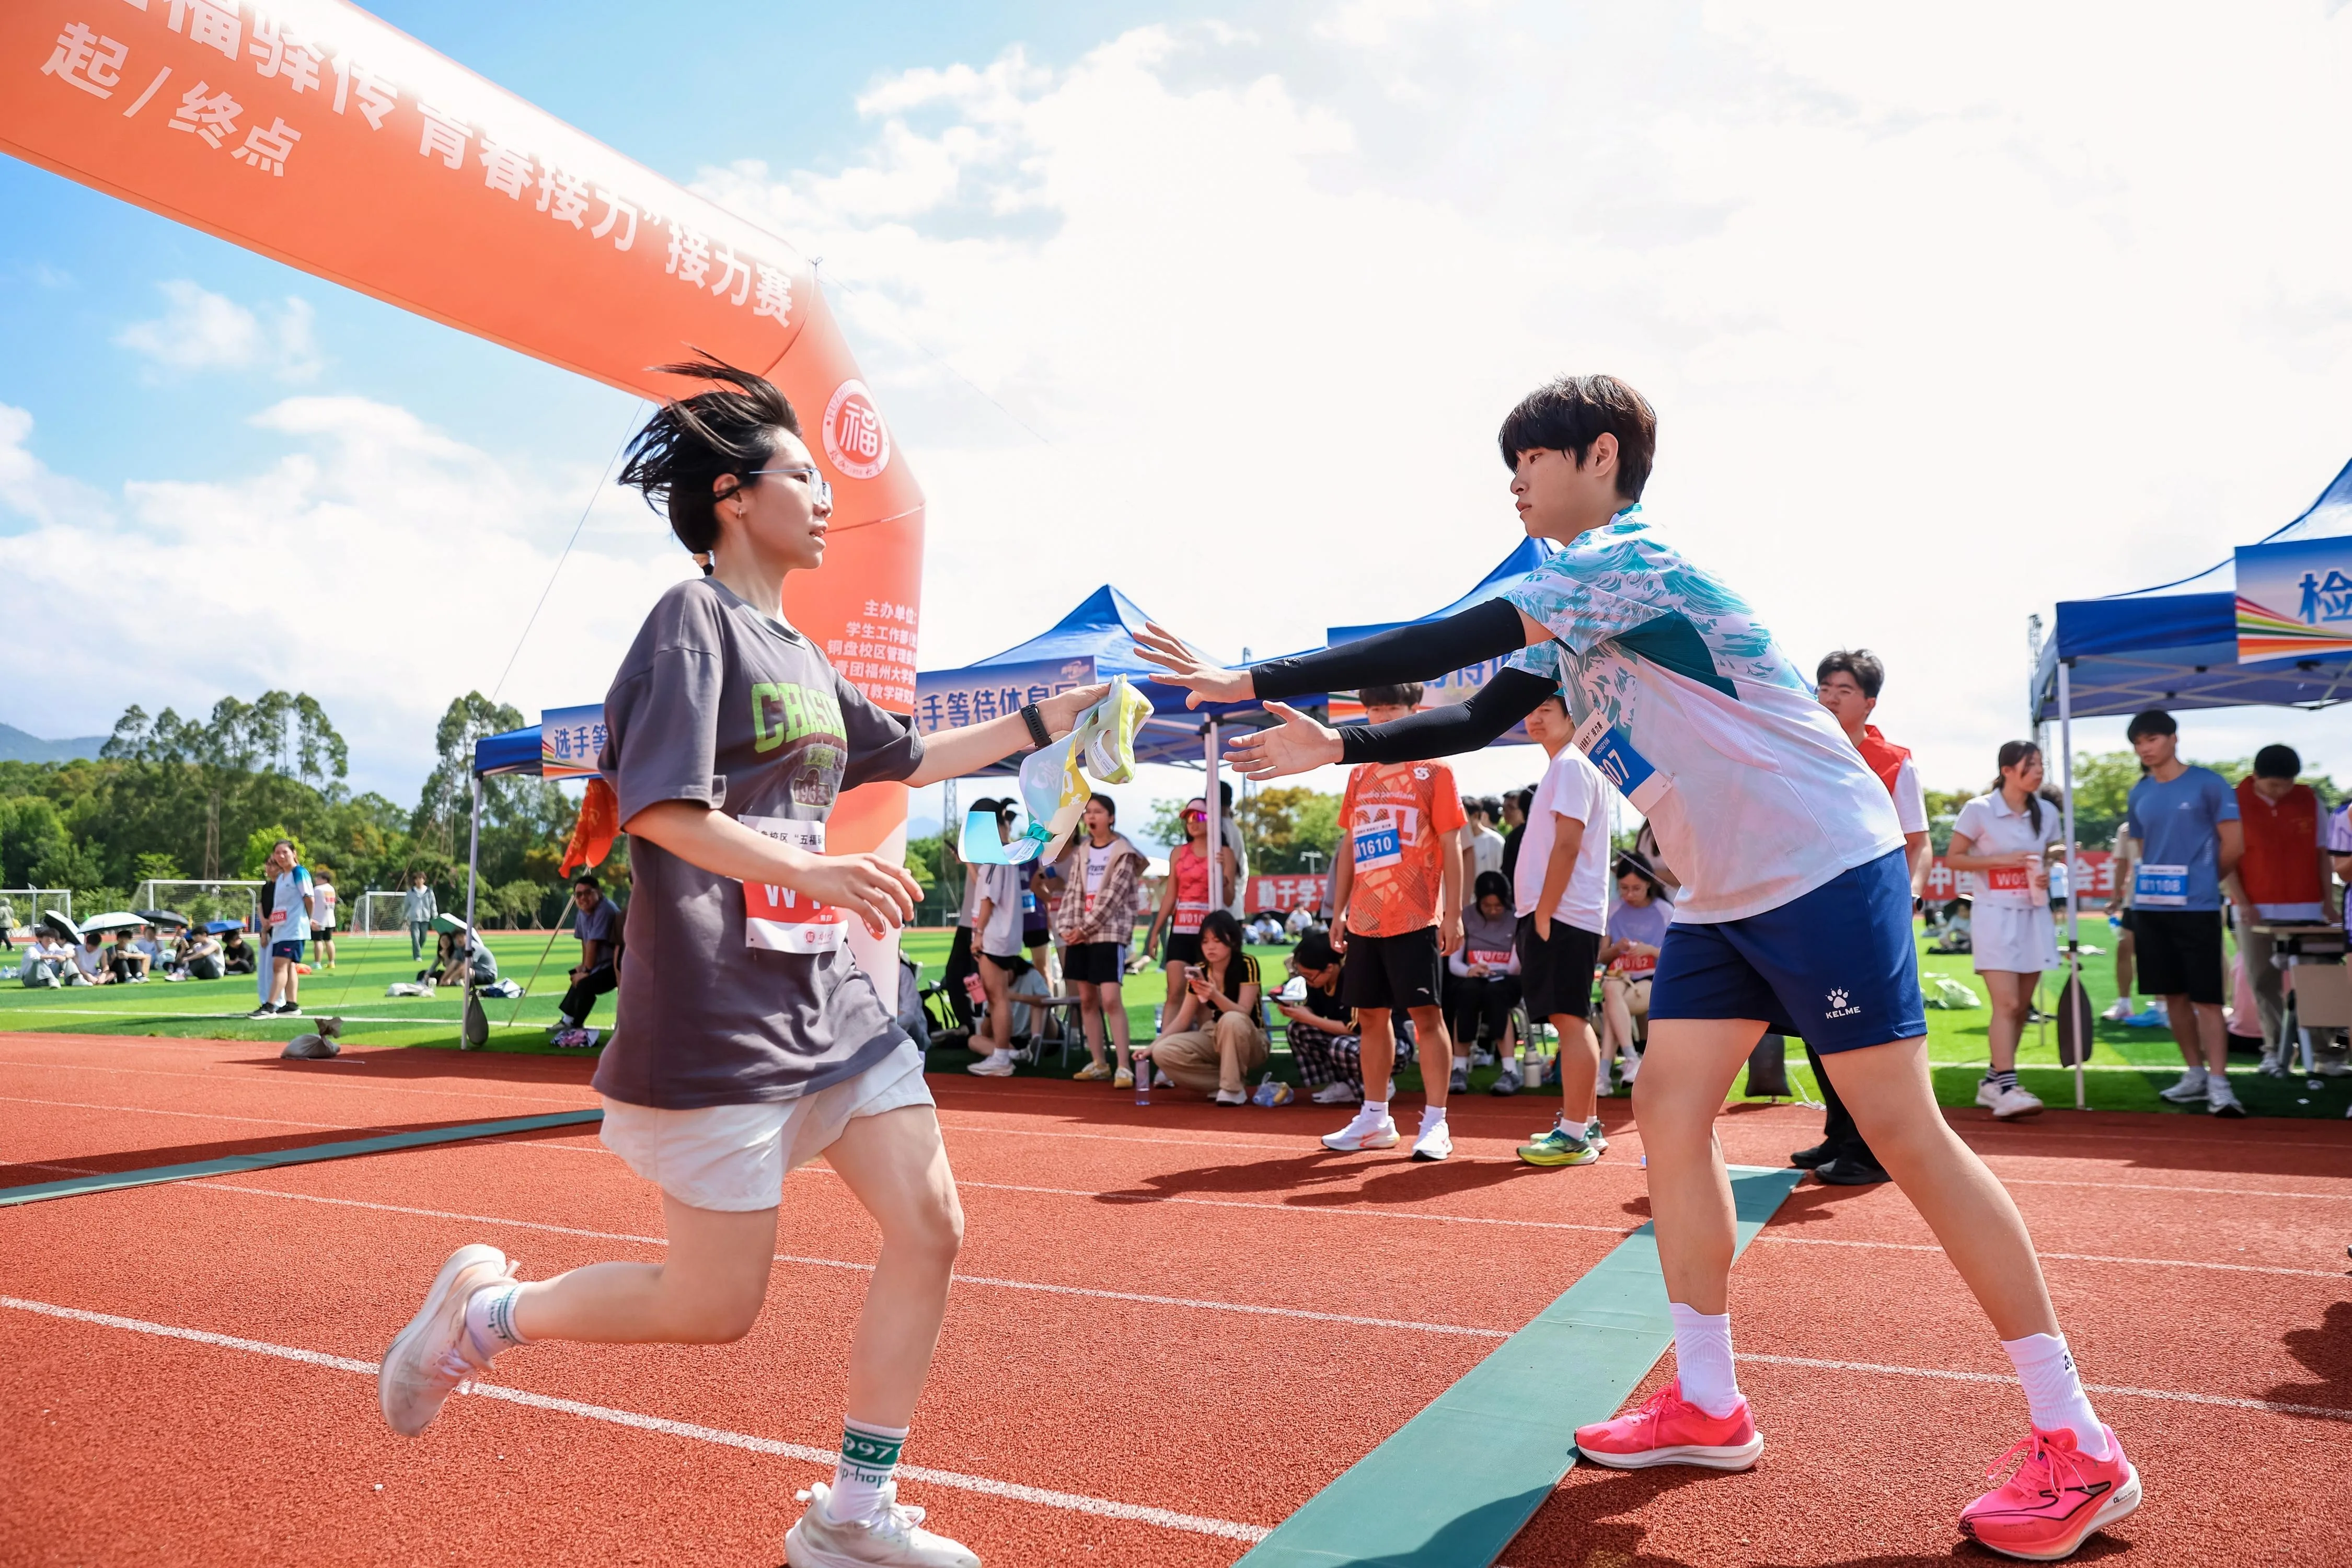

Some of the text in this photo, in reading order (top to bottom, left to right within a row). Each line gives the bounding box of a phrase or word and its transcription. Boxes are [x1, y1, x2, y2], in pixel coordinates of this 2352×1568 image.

[40, 21, 302, 178] 起/终点
[1825, 1006, 1861, 1019] KELME
